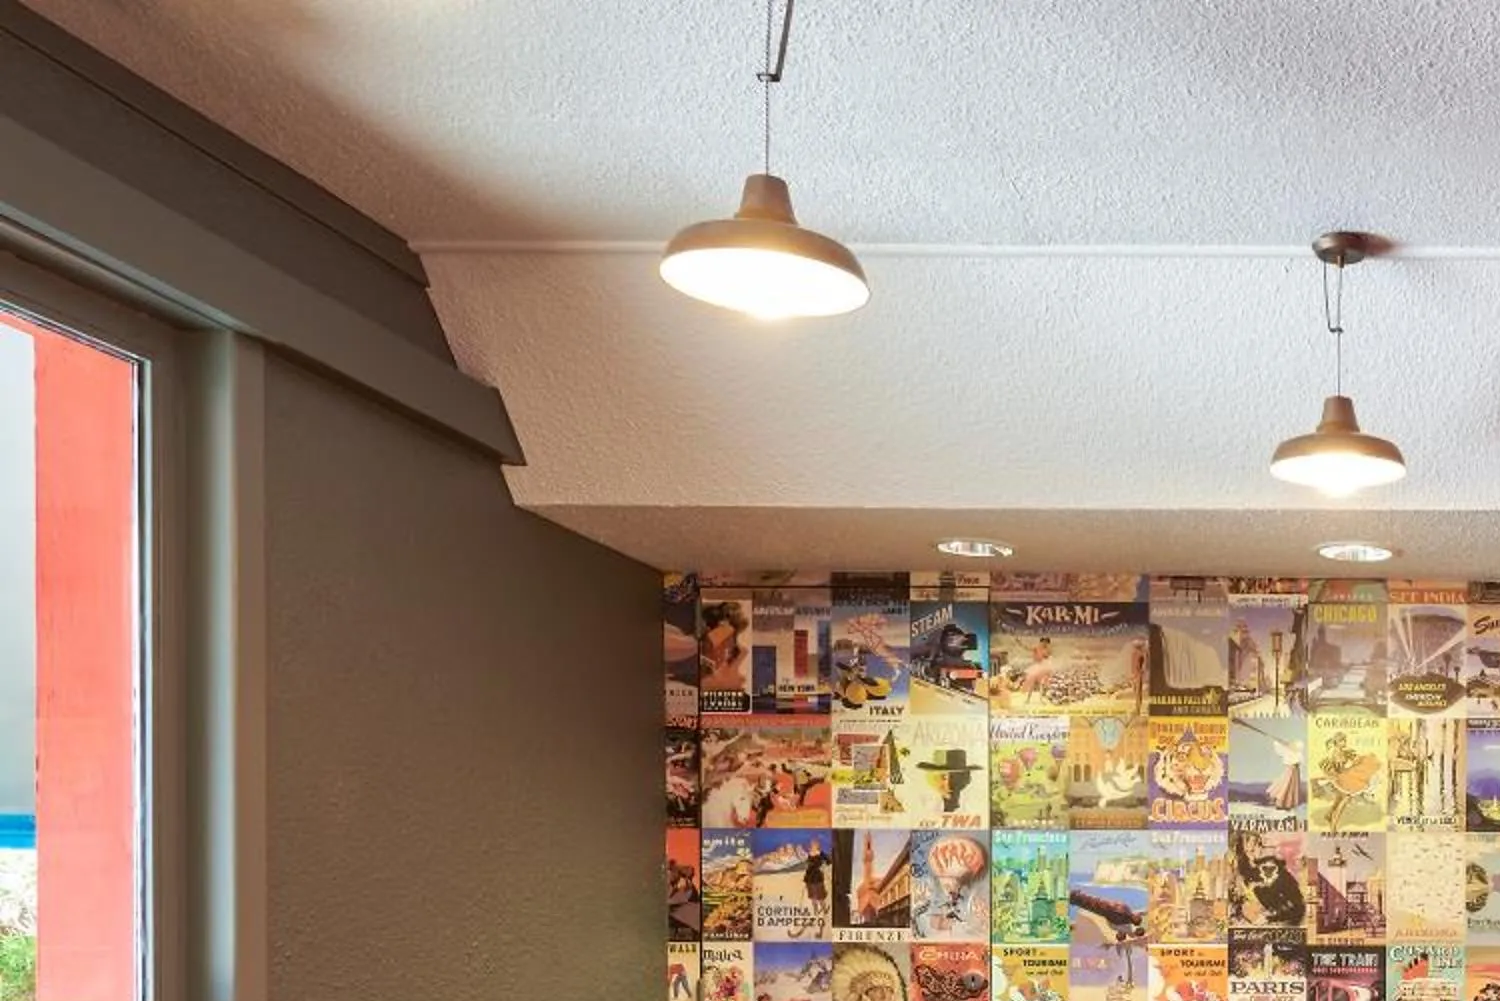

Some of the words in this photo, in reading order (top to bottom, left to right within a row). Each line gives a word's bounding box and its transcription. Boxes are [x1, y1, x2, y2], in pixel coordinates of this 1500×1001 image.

[911, 603, 954, 637] STEAM
[1313, 603, 1377, 623] CHICAGO
[869, 705, 905, 716] ITALY
[1151, 797, 1226, 822] CIRCUS
[941, 814, 982, 828] TWA
[757, 905, 811, 917] CORTINA
[838, 931, 906, 941] FIRENZE
[918, 948, 979, 962] CHINA
[1003, 948, 1037, 957] SPORT
[1160, 948, 1195, 957] SPORT
[1311, 953, 1337, 967] THE
[1340, 952, 1377, 967] TRAIN
[1229, 981, 1306, 995] PARIS
